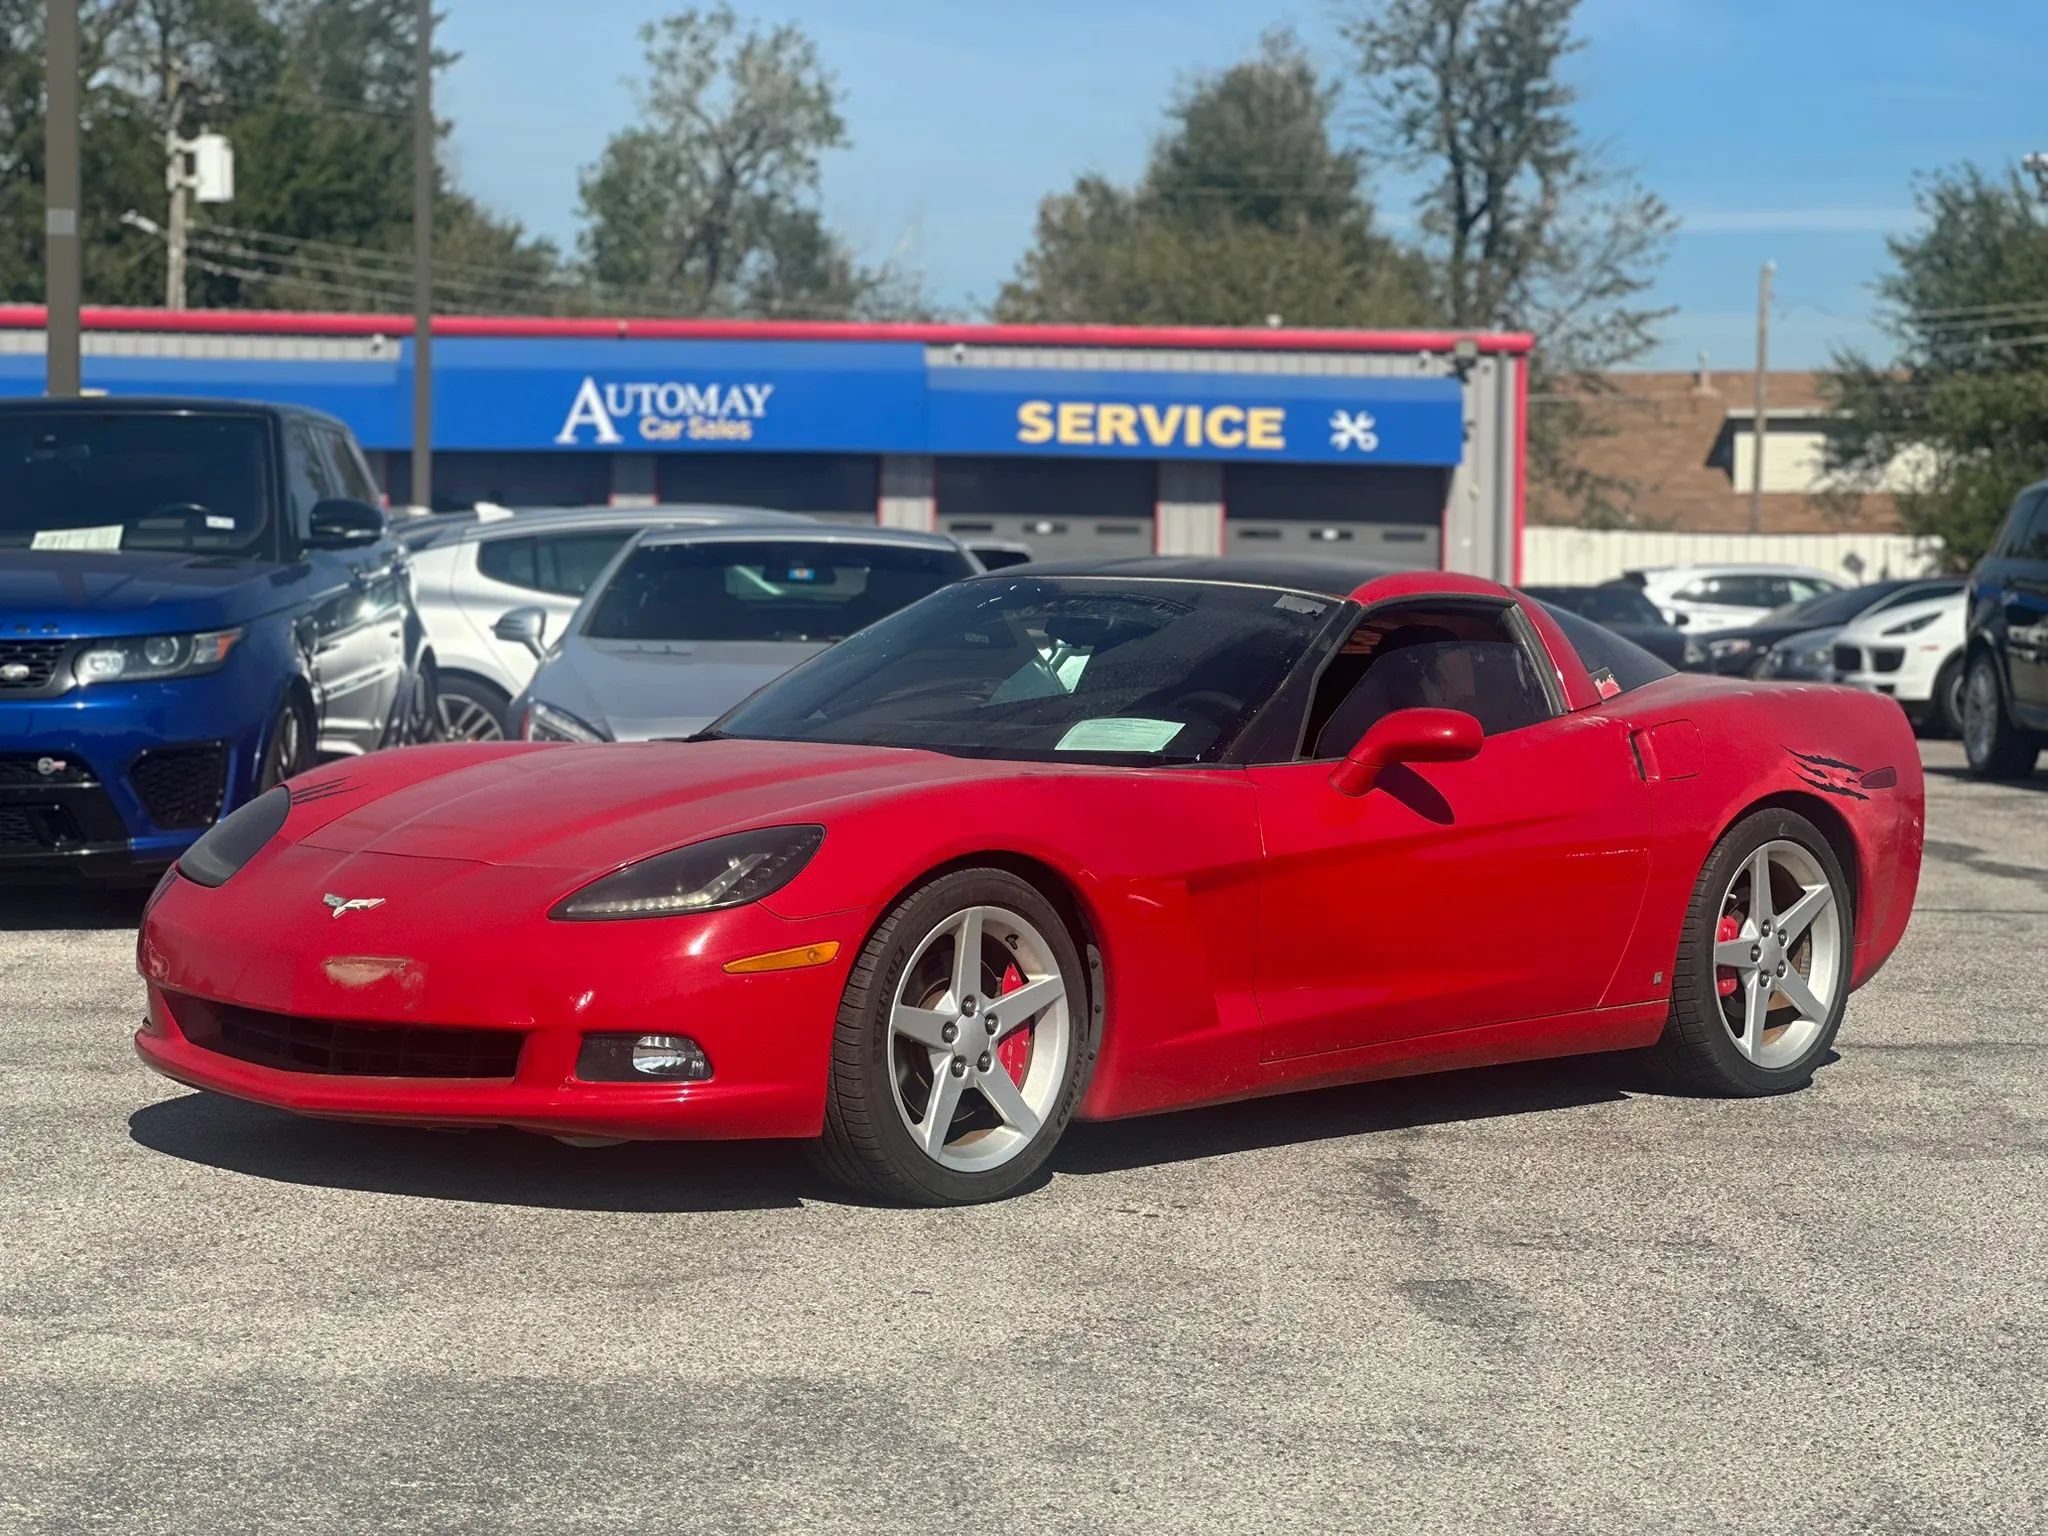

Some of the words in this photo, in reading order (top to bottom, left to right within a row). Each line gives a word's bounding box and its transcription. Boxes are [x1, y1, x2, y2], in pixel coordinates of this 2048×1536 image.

[553, 375, 774, 444] AUTOMAY
[639, 416, 684, 440] Car
[687, 415, 753, 440] Sales
[1017, 400, 1287, 450] SERVICE
